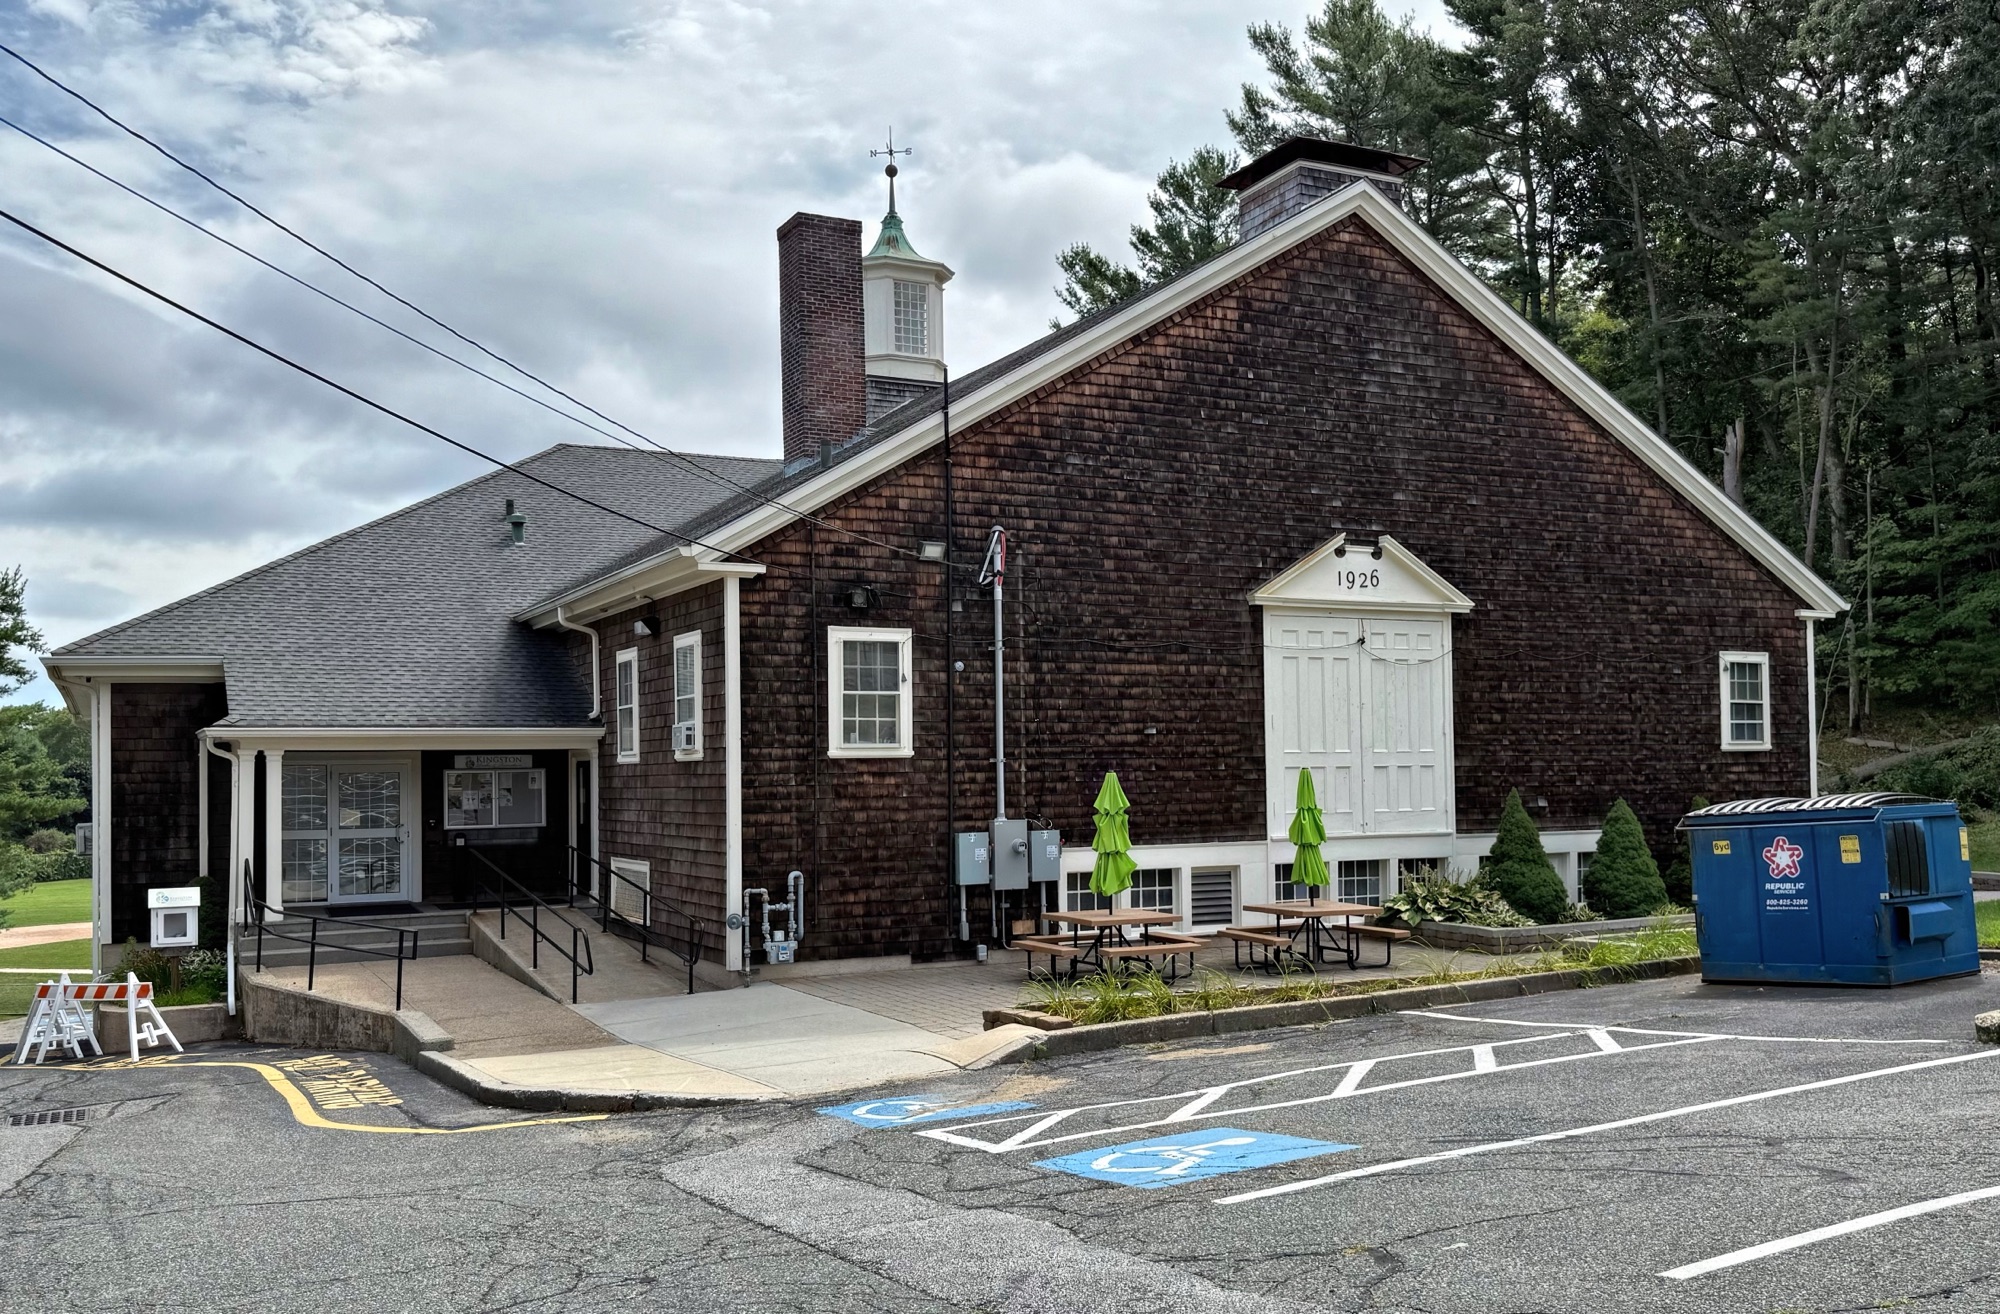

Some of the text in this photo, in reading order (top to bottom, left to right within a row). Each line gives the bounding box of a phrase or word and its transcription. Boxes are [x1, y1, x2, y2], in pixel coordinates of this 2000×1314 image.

[869, 149, 877, 157] N
[905, 147, 912, 155] S
[1338, 569, 1380, 590] 1926
[476, 755, 523, 764] KINGSTON
[1714, 842, 1730, 852] 6yd
[1765, 882, 1806, 890] REPUBLIC
